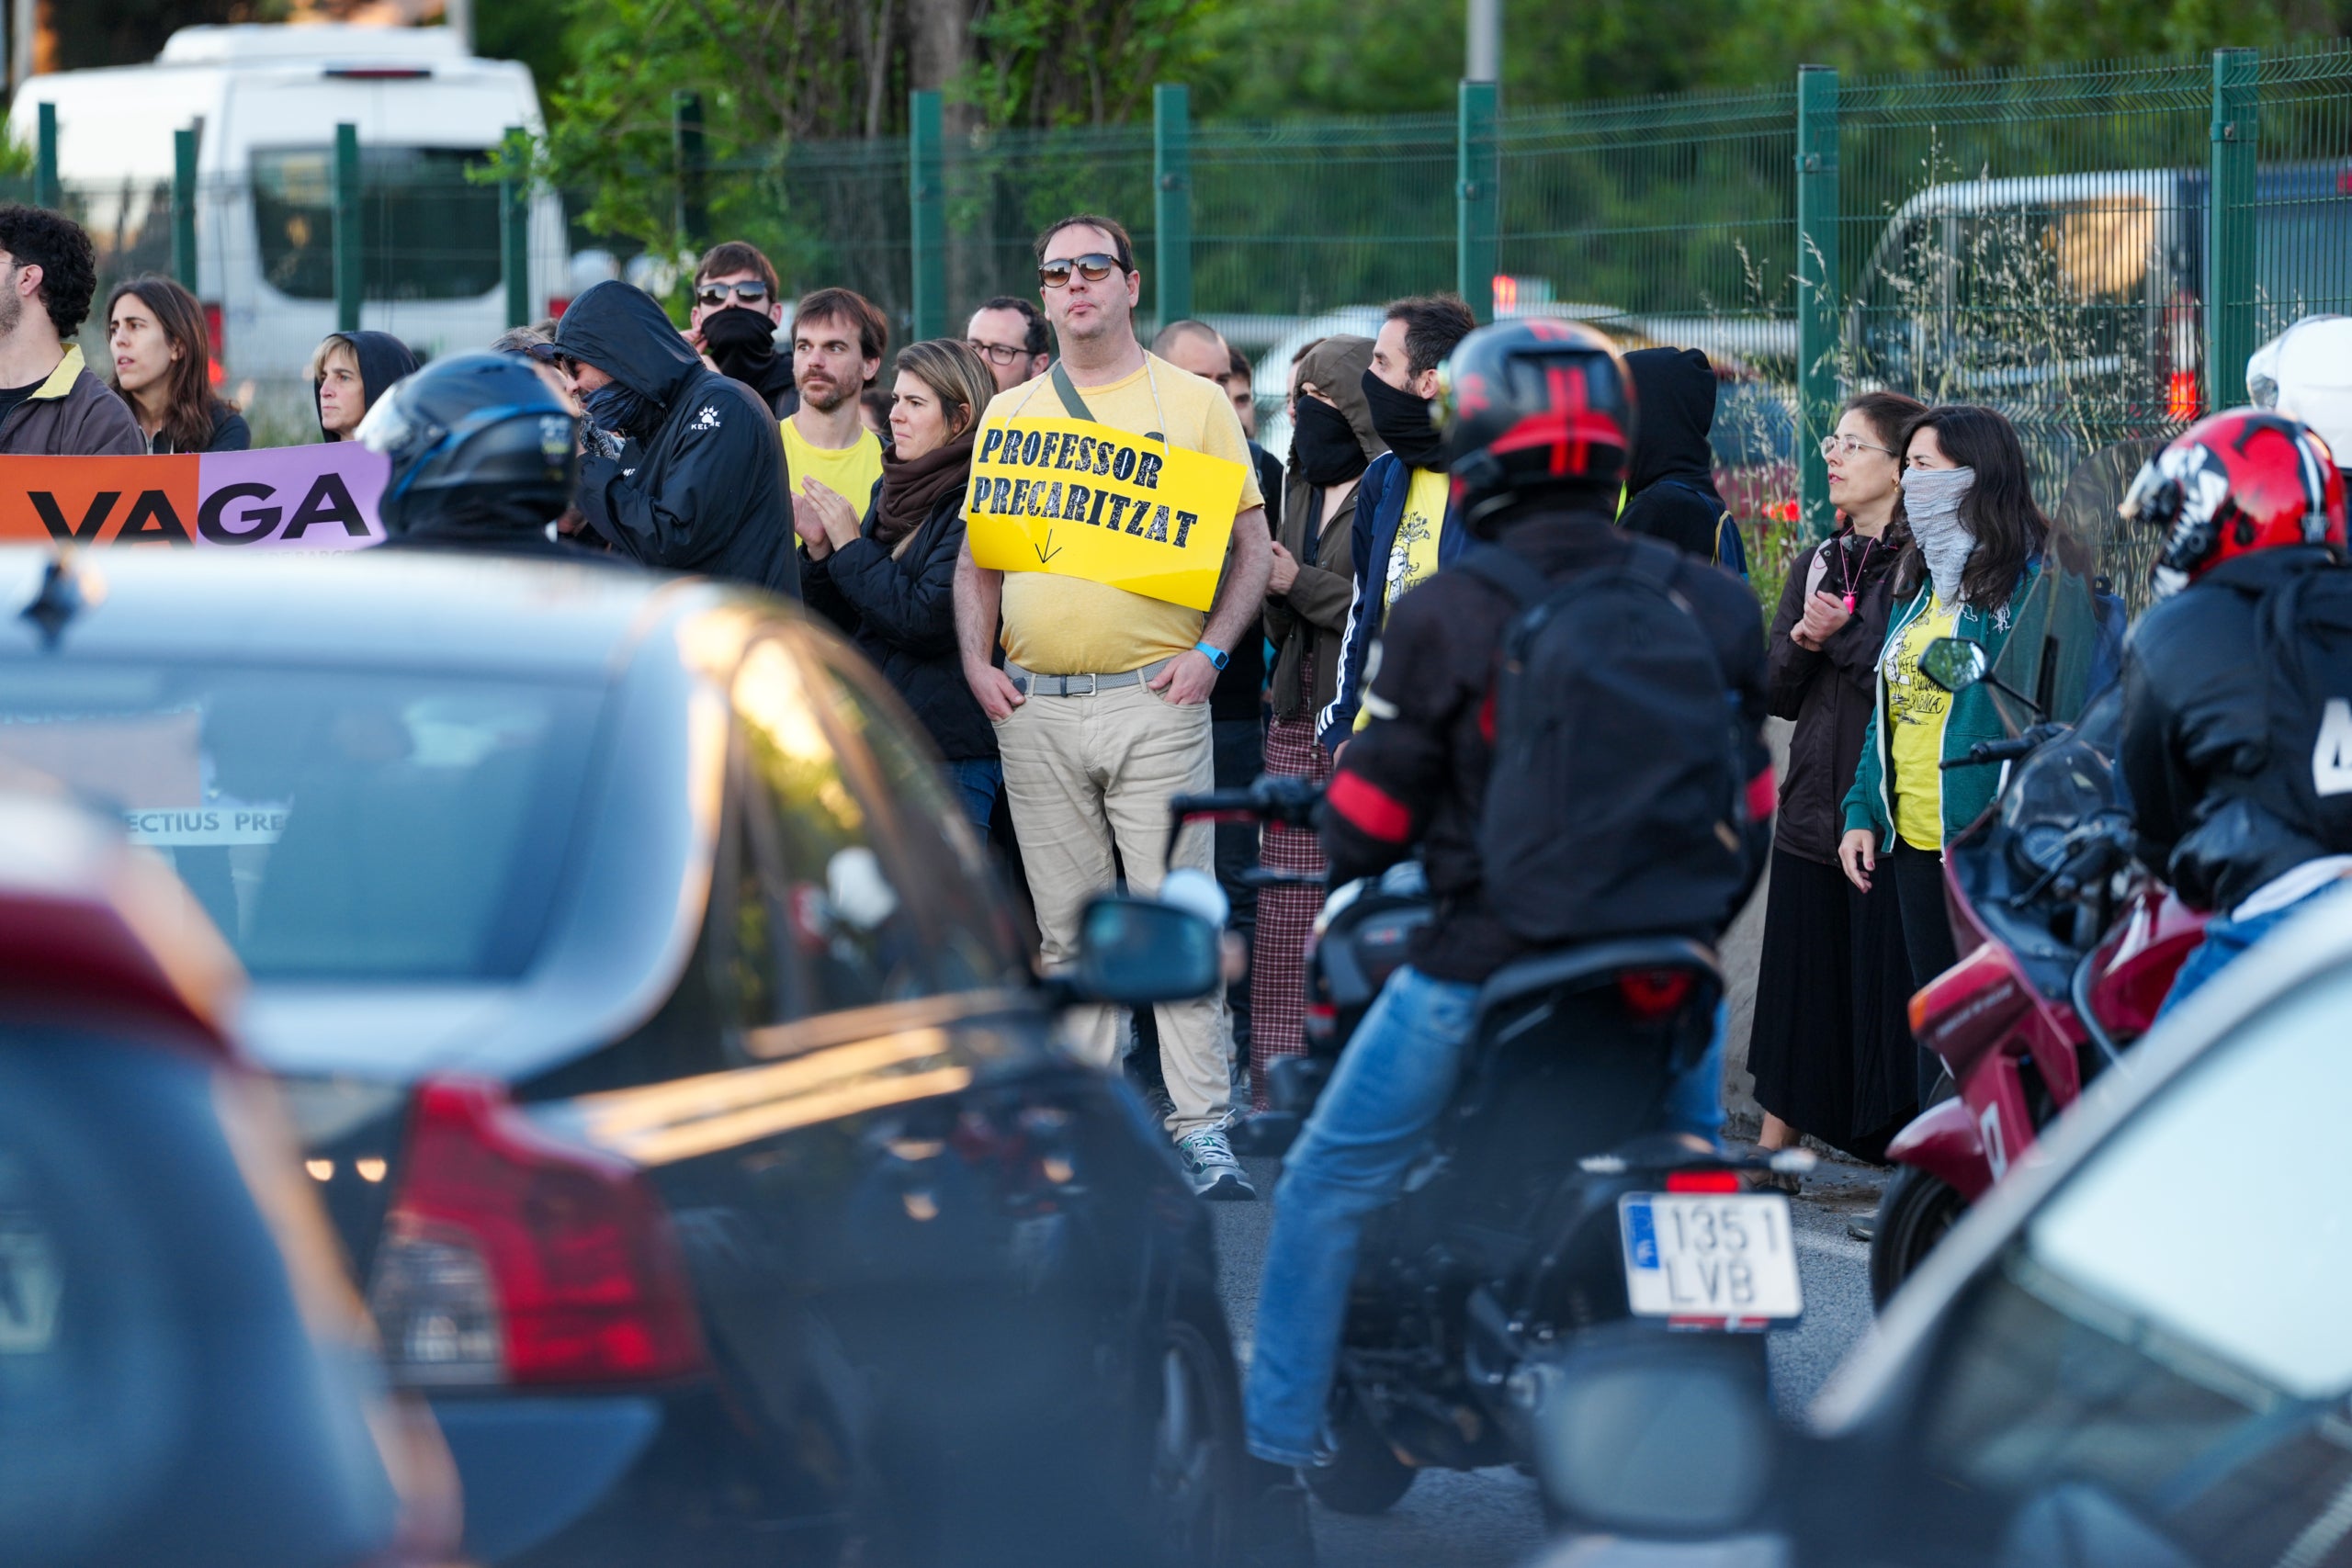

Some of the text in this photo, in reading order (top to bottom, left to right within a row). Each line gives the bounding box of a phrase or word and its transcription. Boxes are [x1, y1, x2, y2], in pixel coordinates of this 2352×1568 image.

[978, 428, 1164, 490] PROFESSOR
[27, 472, 371, 549] VAGA
[970, 476, 1198, 548] PRECARITZAT
[1671, 1204, 1780, 1257] 1351
[1666, 1258, 1756, 1303] LVB
